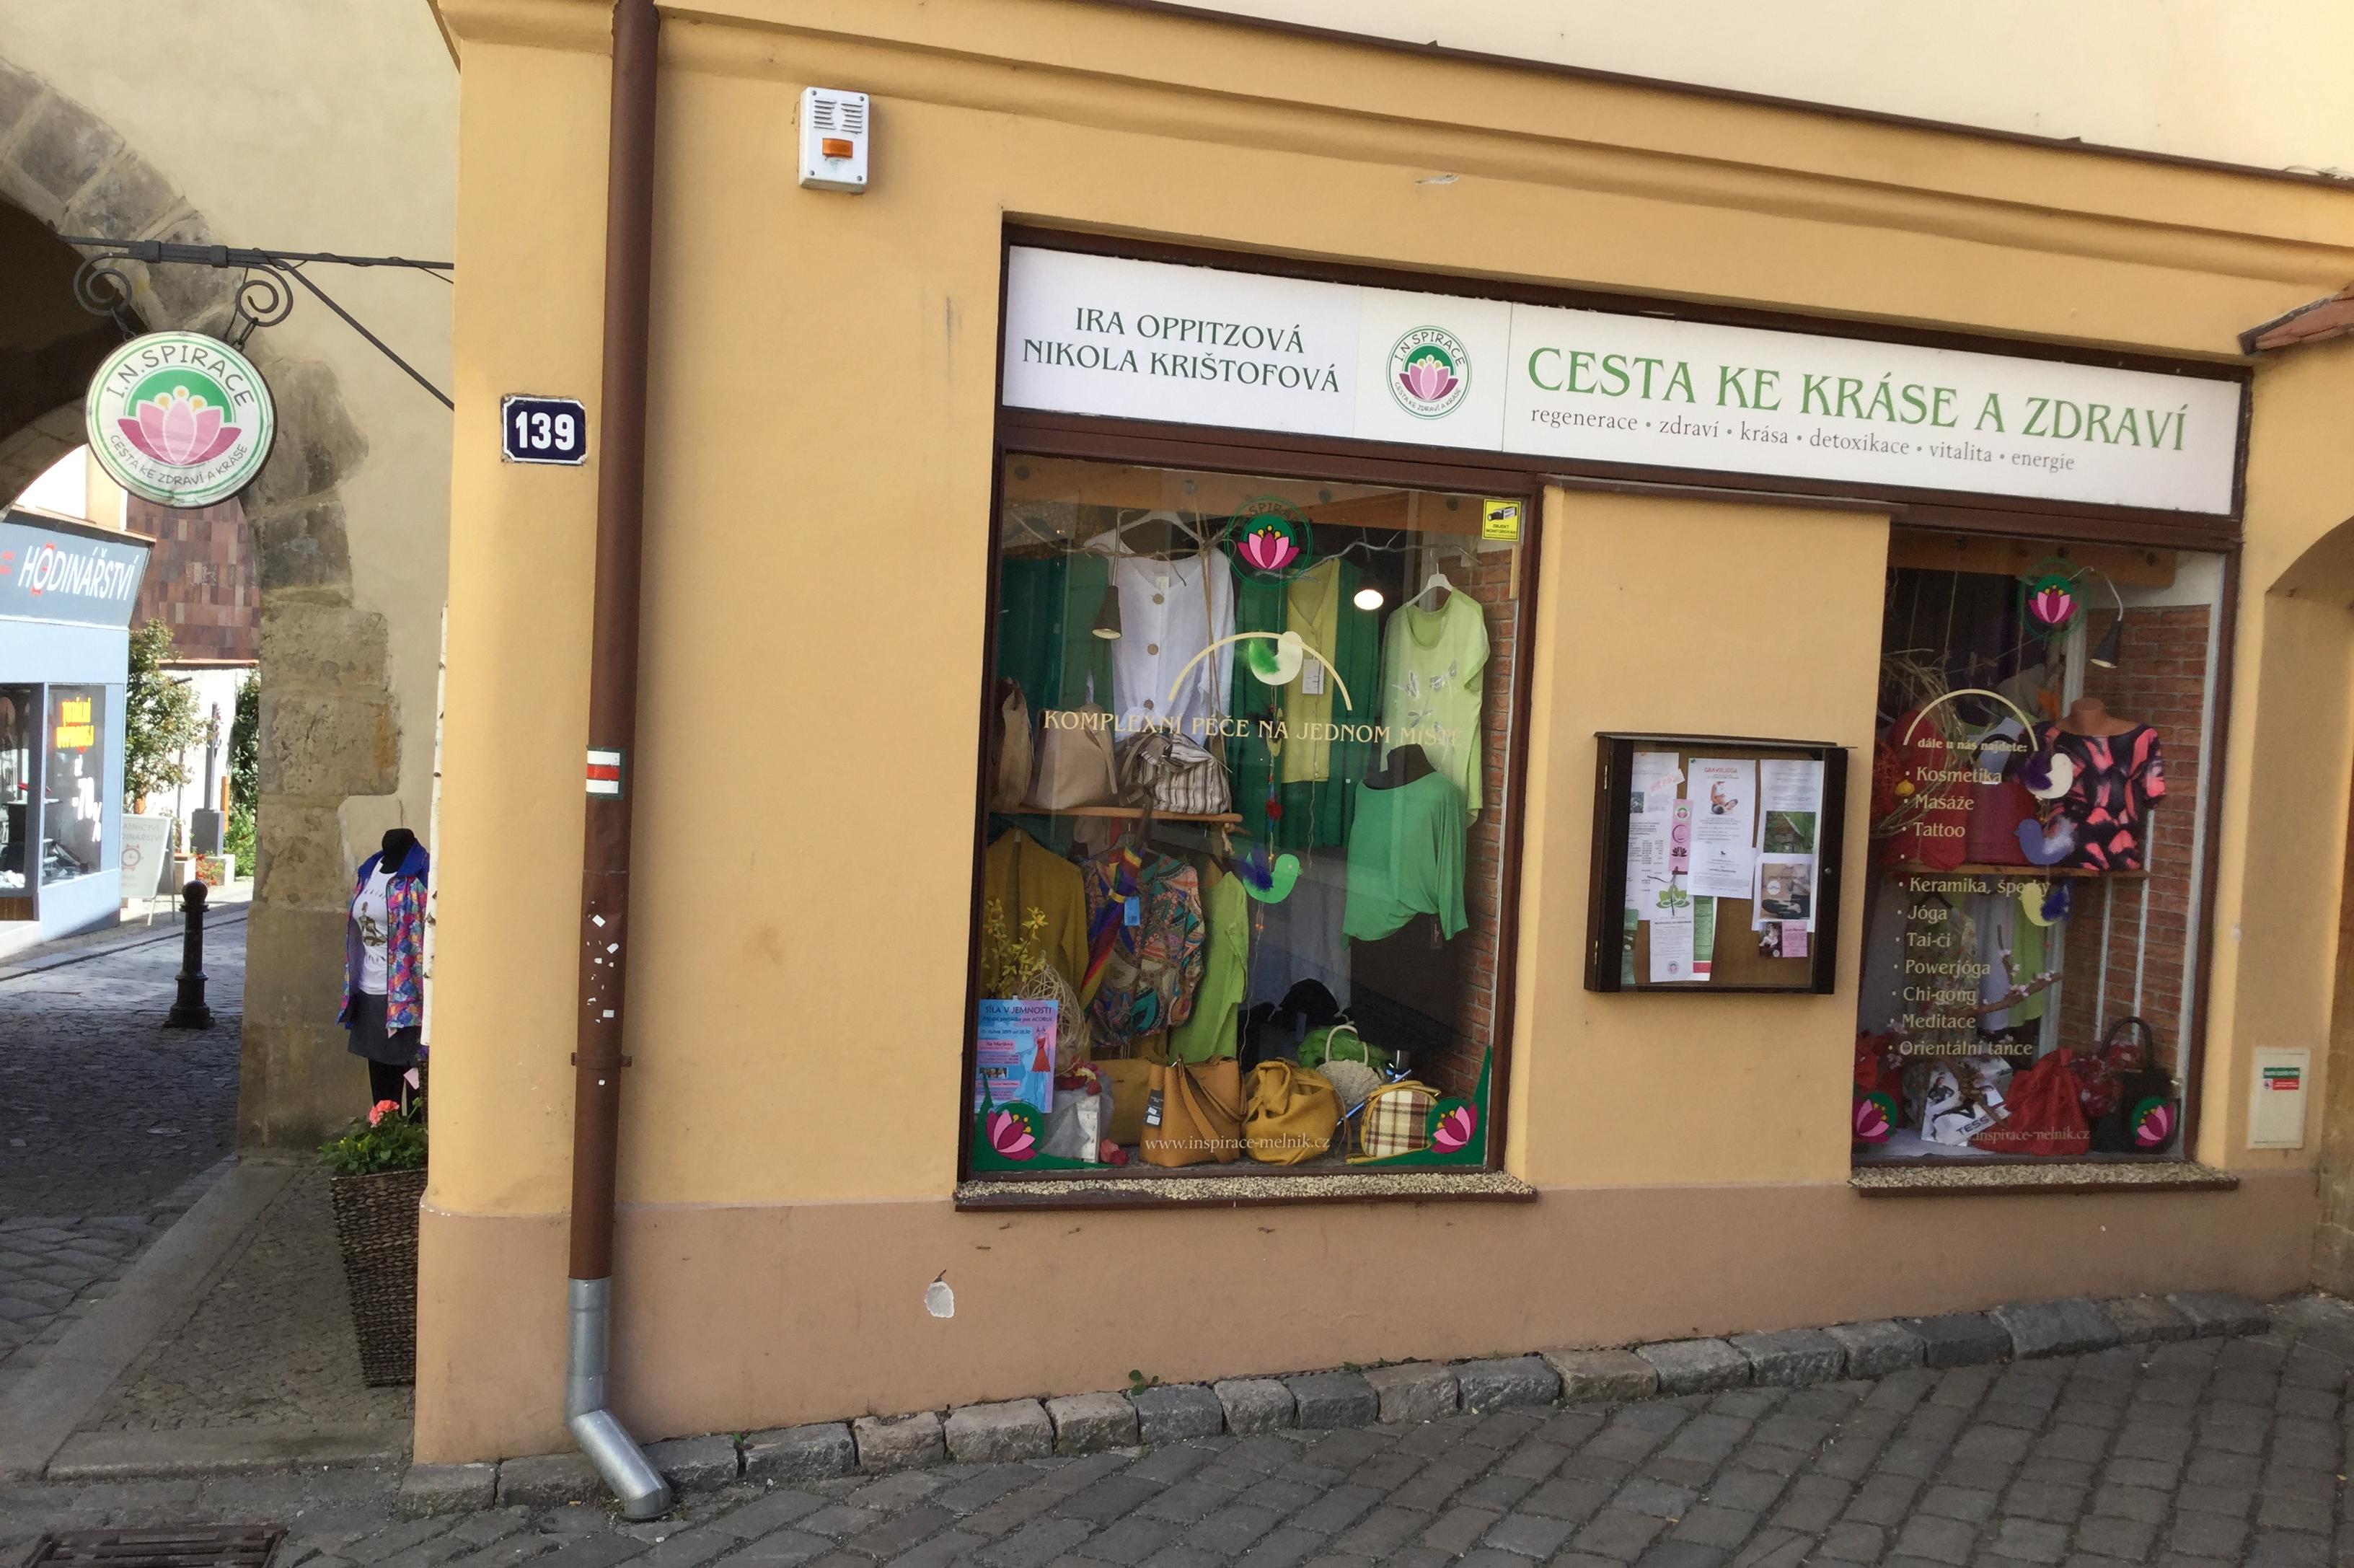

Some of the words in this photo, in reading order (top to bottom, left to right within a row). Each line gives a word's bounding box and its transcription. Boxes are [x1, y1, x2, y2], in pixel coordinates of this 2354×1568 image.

[1075, 307, 1125, 335] IRA
[1136, 314, 1304, 353] OPPITZOVÁ
[1022, 338, 1139, 373] NIKOLA
[1149, 351, 1339, 393] KRIŠTOFOVÁ
[106, 345, 255, 407] I.N.SPIRACE
[1528, 346, 1696, 404] CESTA
[1716, 365, 1783, 412] KE
[1799, 371, 1960, 428] KRÁSE
[1974, 392, 2006, 433] A
[2020, 396, 2189, 452] ZDRAVÍ
[516, 411, 575, 451] 139
[1530, 408, 1639, 431] regenerace
[1659, 415, 1719, 438] zdraví
[1740, 421, 1789, 444] krása
[1809, 428, 1910, 455] detoxikace
[1928, 441, 1993, 463] vitalita
[2011, 452, 2075, 473] energie
[110, 434, 139, 470] CESTA
[139, 464, 157, 480] KE
[157, 473, 205, 485] ZDRAVÍ
[207, 471, 216, 480] A
[216, 444, 247, 475] KRÁSE
[17, 545, 140, 601] HODINÁŘSTVÍ
[1044, 710, 1183, 735] KOMPLEXNÍ
[1191, 714, 1250, 737] PÉČE
[1258, 720, 1289, 739] NA
[1296, 721, 1391, 744] JEDNOM
[1918, 737, 1943, 749] dále
[1957, 739, 1977, 750] nás
[1916, 766, 2002, 783] Kosmetika
[1914, 794, 1975, 811] Masáže
[1913, 822, 1966, 837] Tattoo
[1909, 877, 1991, 894] Keramika,
[1907, 904, 1948, 924] Jóga
[1906, 932, 1951, 948] Tai-či
[1905, 959, 1991, 979] Powerjóga
[1903, 986, 1977, 1005] Chi-gong
[985, 1004, 1002, 1014] SÍLA
[1010, 1005, 1052, 1014] JEMNOSTI
[1902, 1013, 1977, 1029] Meditace
[1899, 1040, 1983, 1056] Orientální
[1988, 1041, 2033, 1056] tance
[1145, 1132, 1331, 1153] www.inspirace-melnik.cz
